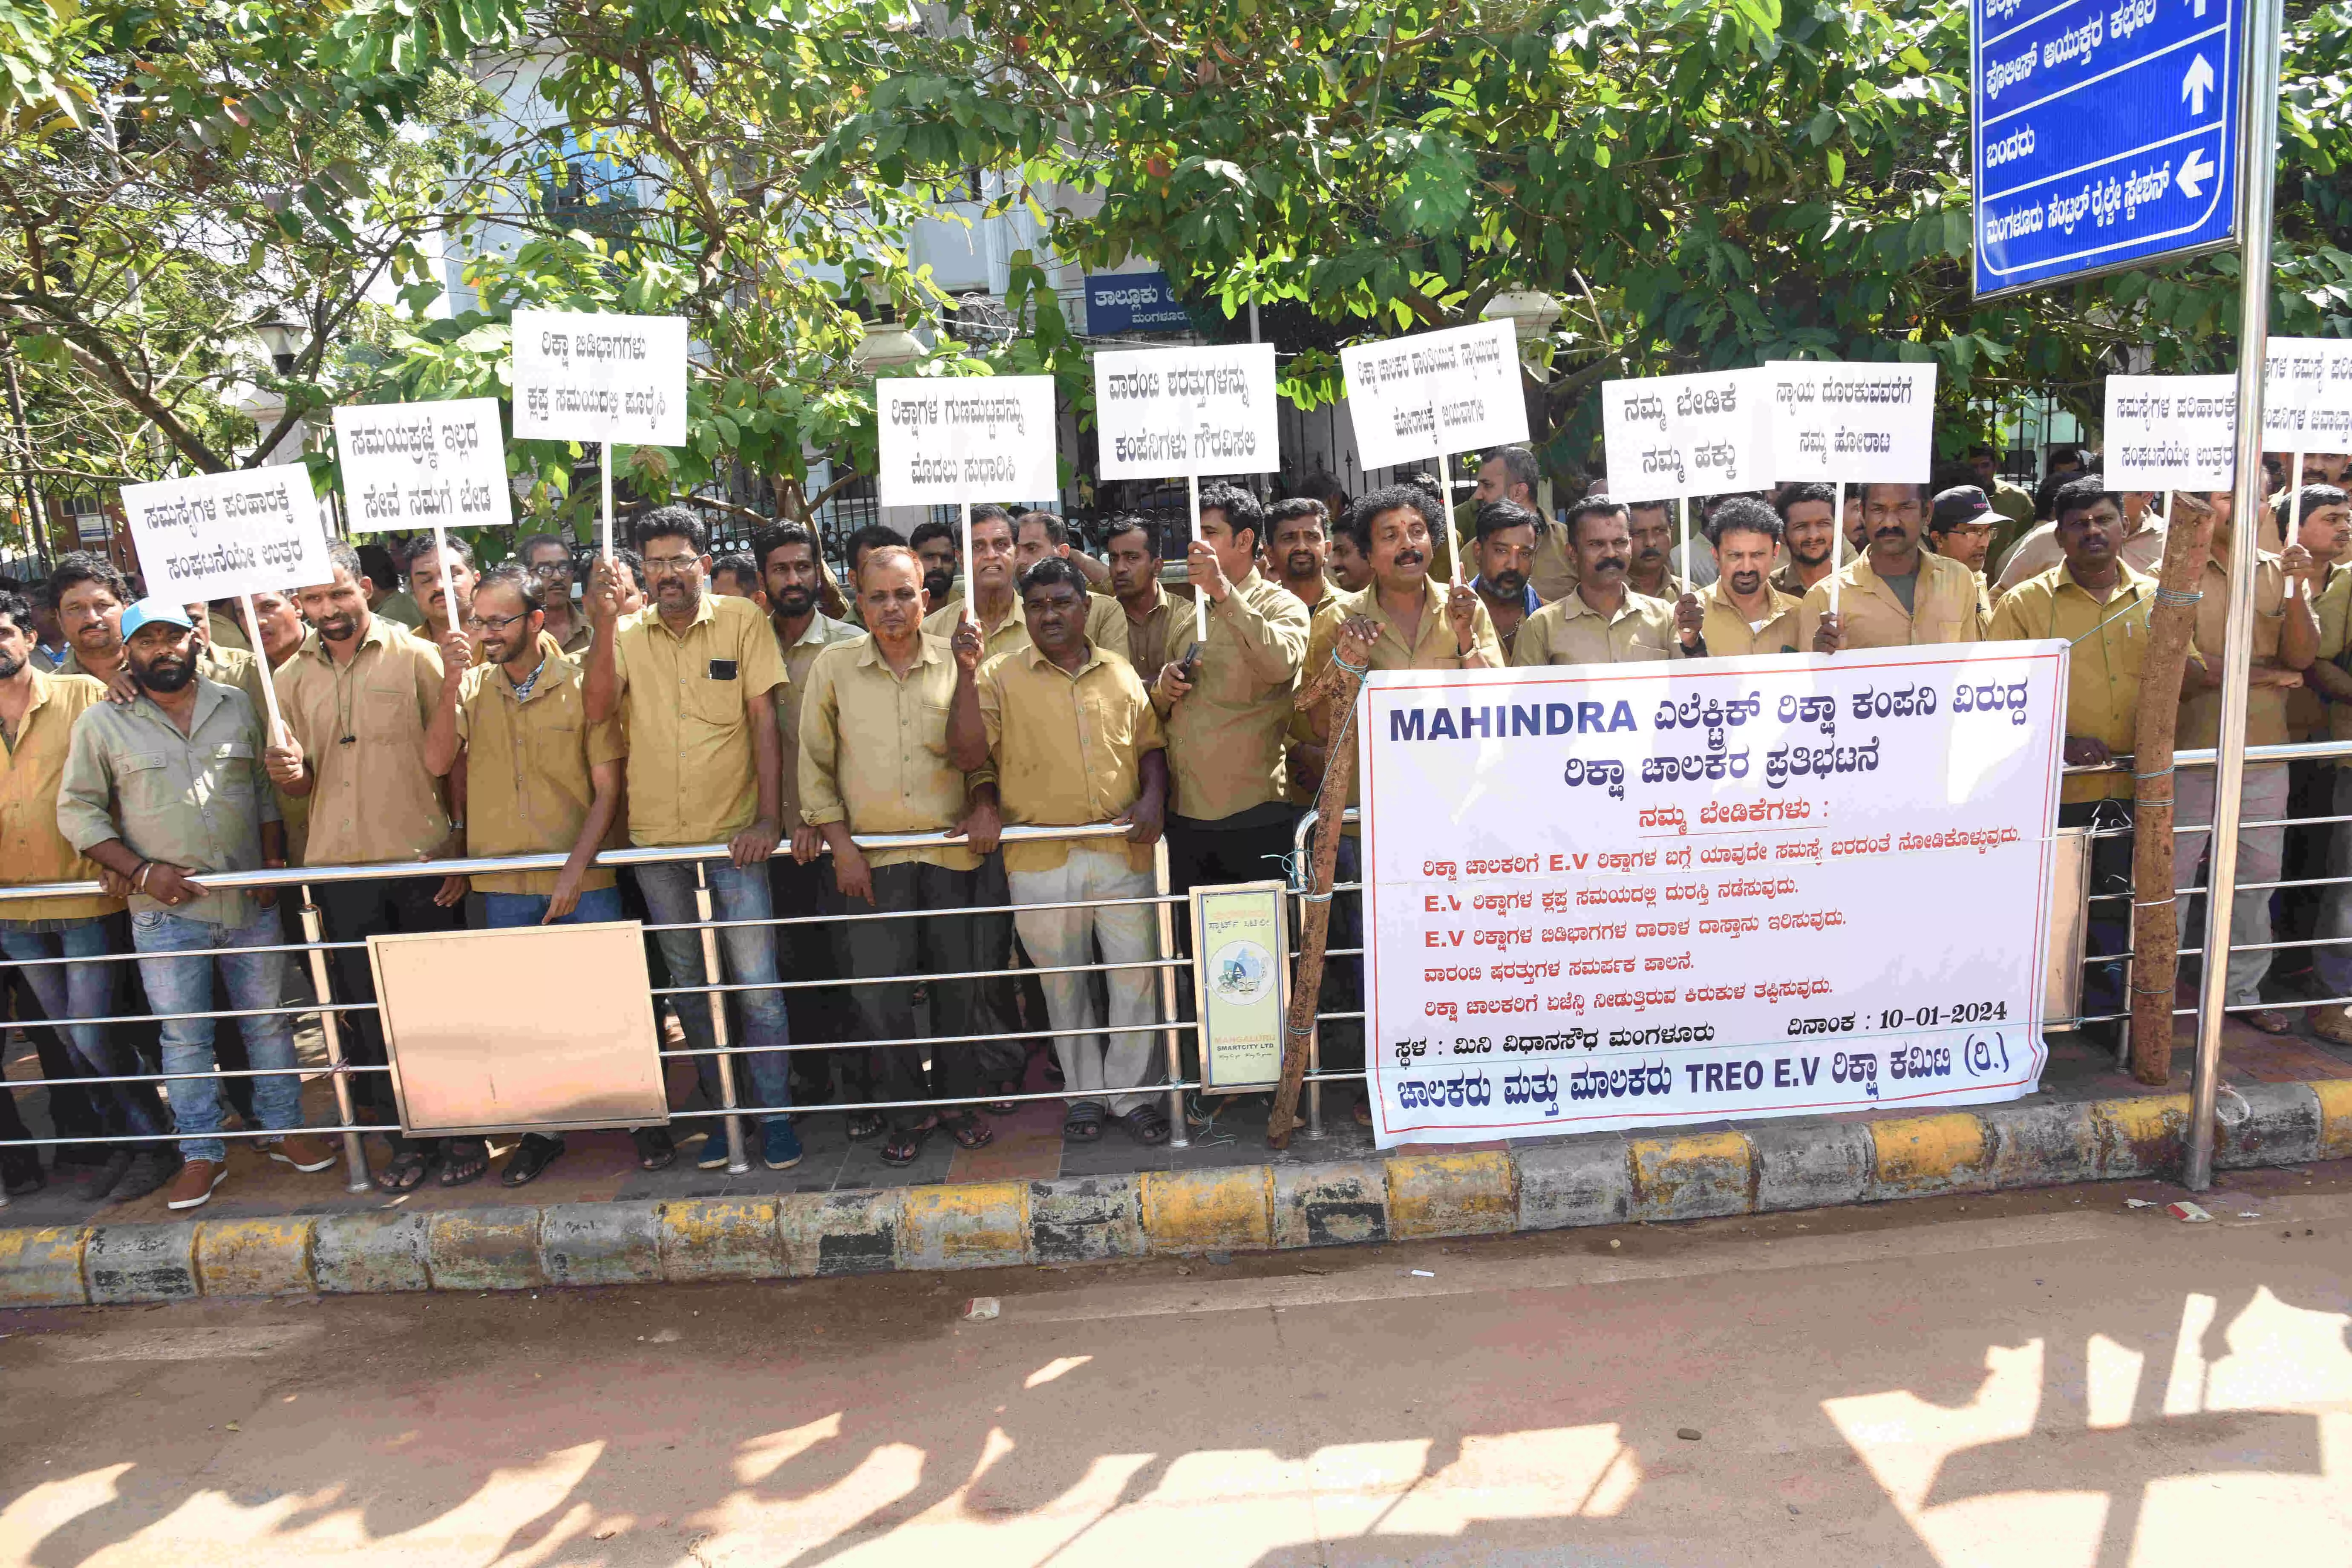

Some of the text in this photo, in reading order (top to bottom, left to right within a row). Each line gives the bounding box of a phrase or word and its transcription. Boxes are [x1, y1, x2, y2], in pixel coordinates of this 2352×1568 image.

[2044, 10, 2104, 68] ಆಯುಕ್ತರ
[1986, 123, 2035, 168] ಬಂದರು
[1986, 199, 2044, 244] ಮಂಗಳೂರು
[2048, 184, 2090, 235] ಸೆಂಟ್ರಲ್
[1094, 283, 1158, 311] ತಾಲ್ಲೂಕು
[542, 329, 646, 370] ರಿಕ್ಷಾ ಬಿಡಿಭಾಗಗಳು
[1109, 366, 1159, 400] ವಾರಂಟಿ
[2292, 351, 2325, 394] ಸಮಸ್ಯೆ
[556, 384, 618, 424] ಸಮಯದಲ್ಲಿ
[891, 391, 1024, 440] ರಿಕ್ಷಾಗಳ ಗುಣಮಟ್ಟವನ್ನು
[1624, 383, 1736, 432] ನಮ್ಮ ಬೇಡಿಕೆ
[1776, 375, 1913, 416] ನ್ಯಾಯ ದೊರಕುವವರೆಗೆ
[2117, 392, 2170, 432] ಸಮಸ್ಯೆಗಳ
[442, 416, 478, 461] ಇಲ್ಲದ
[1115, 422, 1256, 462] ಕಂಪೆನಿಗಳು ಗೌರವಿಸಲಿ
[1799, 425, 1891, 464] ನಮ್ಮ ಹೋರಾಟ
[2311, 410, 2352, 444] ಜವಾಬ್ದಾ
[911, 452, 1016, 487] ಮೊದಲು ಸುಧಾರಿಸಿ
[1642, 438, 1737, 483] ನಮ್ಮ ಹಕ್ಕು
[2121, 440, 2234, 476] ಸಂಘಟನೆಯೇ ಉತ್ತರ
[144, 496, 217, 537] ಸಮಸ್ಯೆಗಳ
[223, 482, 294, 524] ಪರಿಹಾರಕ್ಕೆ
[364, 478, 491, 518] ಸೇವೆ ನಮಗೆ ಬೇಡ
[167, 534, 303, 580] ಸಂಘಟನೆಯೇ ಉತ್ತರ
[1389, 700, 1637, 742] MAHINDRA
[1654, 689, 1761, 751] ಎಲೆಕ್ಟ್ರಿಕ್
[1777, 690, 1836, 738] ರಿಕ್ಷಾ
[1852, 682, 1937, 721] ಕಂಪನಿ
[1564, 735, 1880, 801] ರಿಕ್ಷಾ ಚಾಲಕರ ಪ್ರತಿಭಟನೆ
[1639, 801, 1687, 835] ನಮ್ಮ
[1700, 796, 1810, 824] ಬೇಡಿಕೆಗಳು
[1423, 824, 2022, 884] ರಿಕ್ಷಾ ಚಾಲಕರಿಗೆ E.V ರಿಕ್ಷಾಗಳ ಬಗ್ಗೆ ಯಾವುದೇ ಸಮಸ್ಯೆ ಬರದಂತೆ ನೋಡಿಕೊಳ್ಳುವುದು.
[1424, 894, 1462, 913] E.V
[1473, 890, 1534, 919] ರಿಕ್ಷಾಗಳ
[1576, 882, 1657, 909] ಸಮಯದಲ್ಲಿ
[1666, 879, 1710, 907] ದುರಸ್ತಿ
[1718, 875, 1799, 899] ನಡೆಸುವುದು.
[1424, 928, 1465, 948] E.V
[1473, 925, 1534, 954] ರಿಕ್ಷಾಗಳ
[1541, 920, 1627, 945] ಬಿಡಿಭಾಗಗಳ
[1698, 912, 1760, 939] ದಾಸ್ತಾನು
[1768, 907, 1847, 932] ಇರಿಸುವುದು.
[1423, 950, 1695, 985] ವಾರಂಟಿ ಷರತ್ತುಗಳ ಸಮರ್ಪಕ ಪಾಲನೆ.
[1424, 976, 1833, 1023] ರಿಕ್ಷಾ ಚಾಲಕರಿಗೆ ಏಜೆನ್ಸಿ ನೀಡುತ್ತಿರುವ ಕಿರುಕುಳ ತಪ್ಪಿಸುವುದು.
[1395, 1035, 1427, 1070] ಸ್ಥಳ
[1453, 1035, 1493, 1056] ಮಿನಿ
[1503, 1026, 1599, 1056] ವಿಧಾನಸೌಧ
[1609, 1020, 1715, 1048] ಮಂಗಳೂರು
[1787, 1010, 1856, 1036] ದಿನಾಂಕ
[1879, 1000, 2007, 1029] 10-01-2024
[1397, 1031, 2010, 1117] ಚಾಲಕರು ಮತ್ತು ಮಾಲಕರು TREO E.V ರಿಕ್ಷಾ ಕಮಿಟಿ (ರಿ.)
